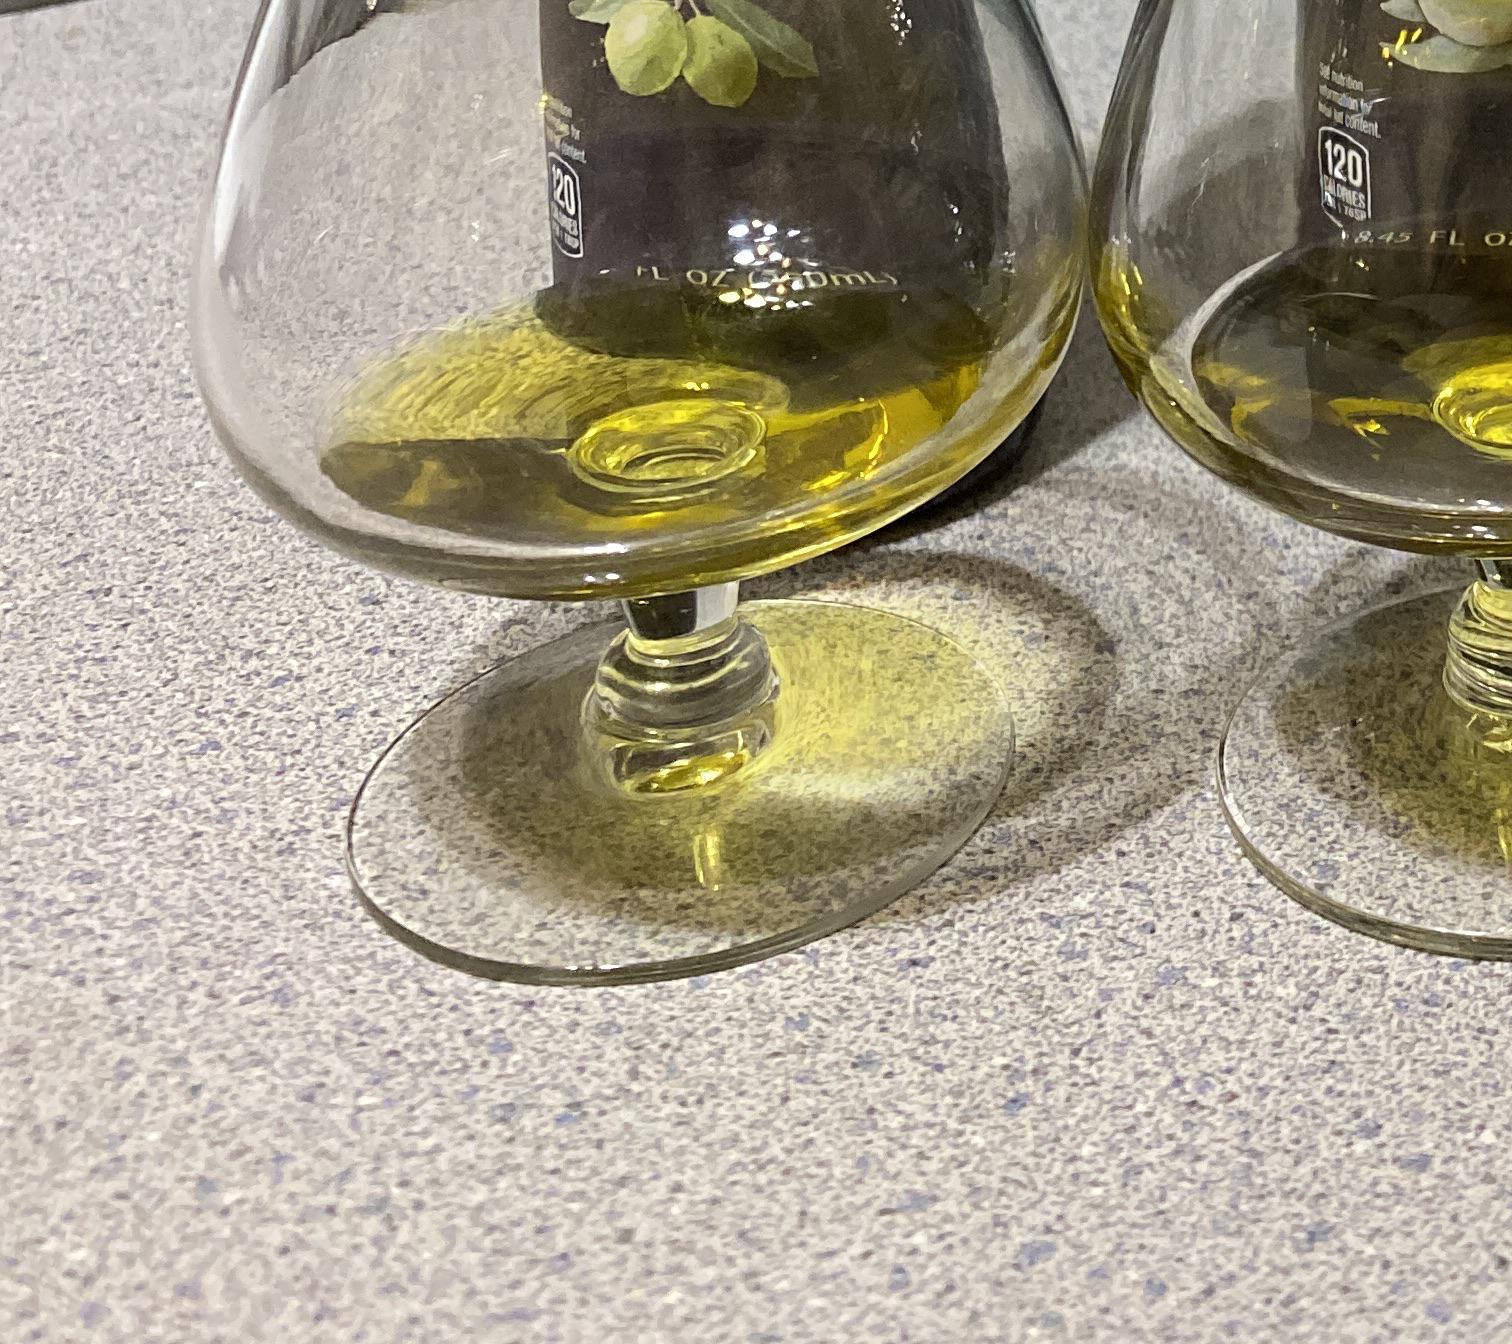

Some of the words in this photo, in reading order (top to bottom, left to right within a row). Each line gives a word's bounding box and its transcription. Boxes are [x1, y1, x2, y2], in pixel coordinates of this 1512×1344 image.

[1324, 139, 1363, 188] 120
[551, 163, 577, 215] 120
[1429, 229, 1465, 247] FL
[685, 267, 732, 288] OZ
